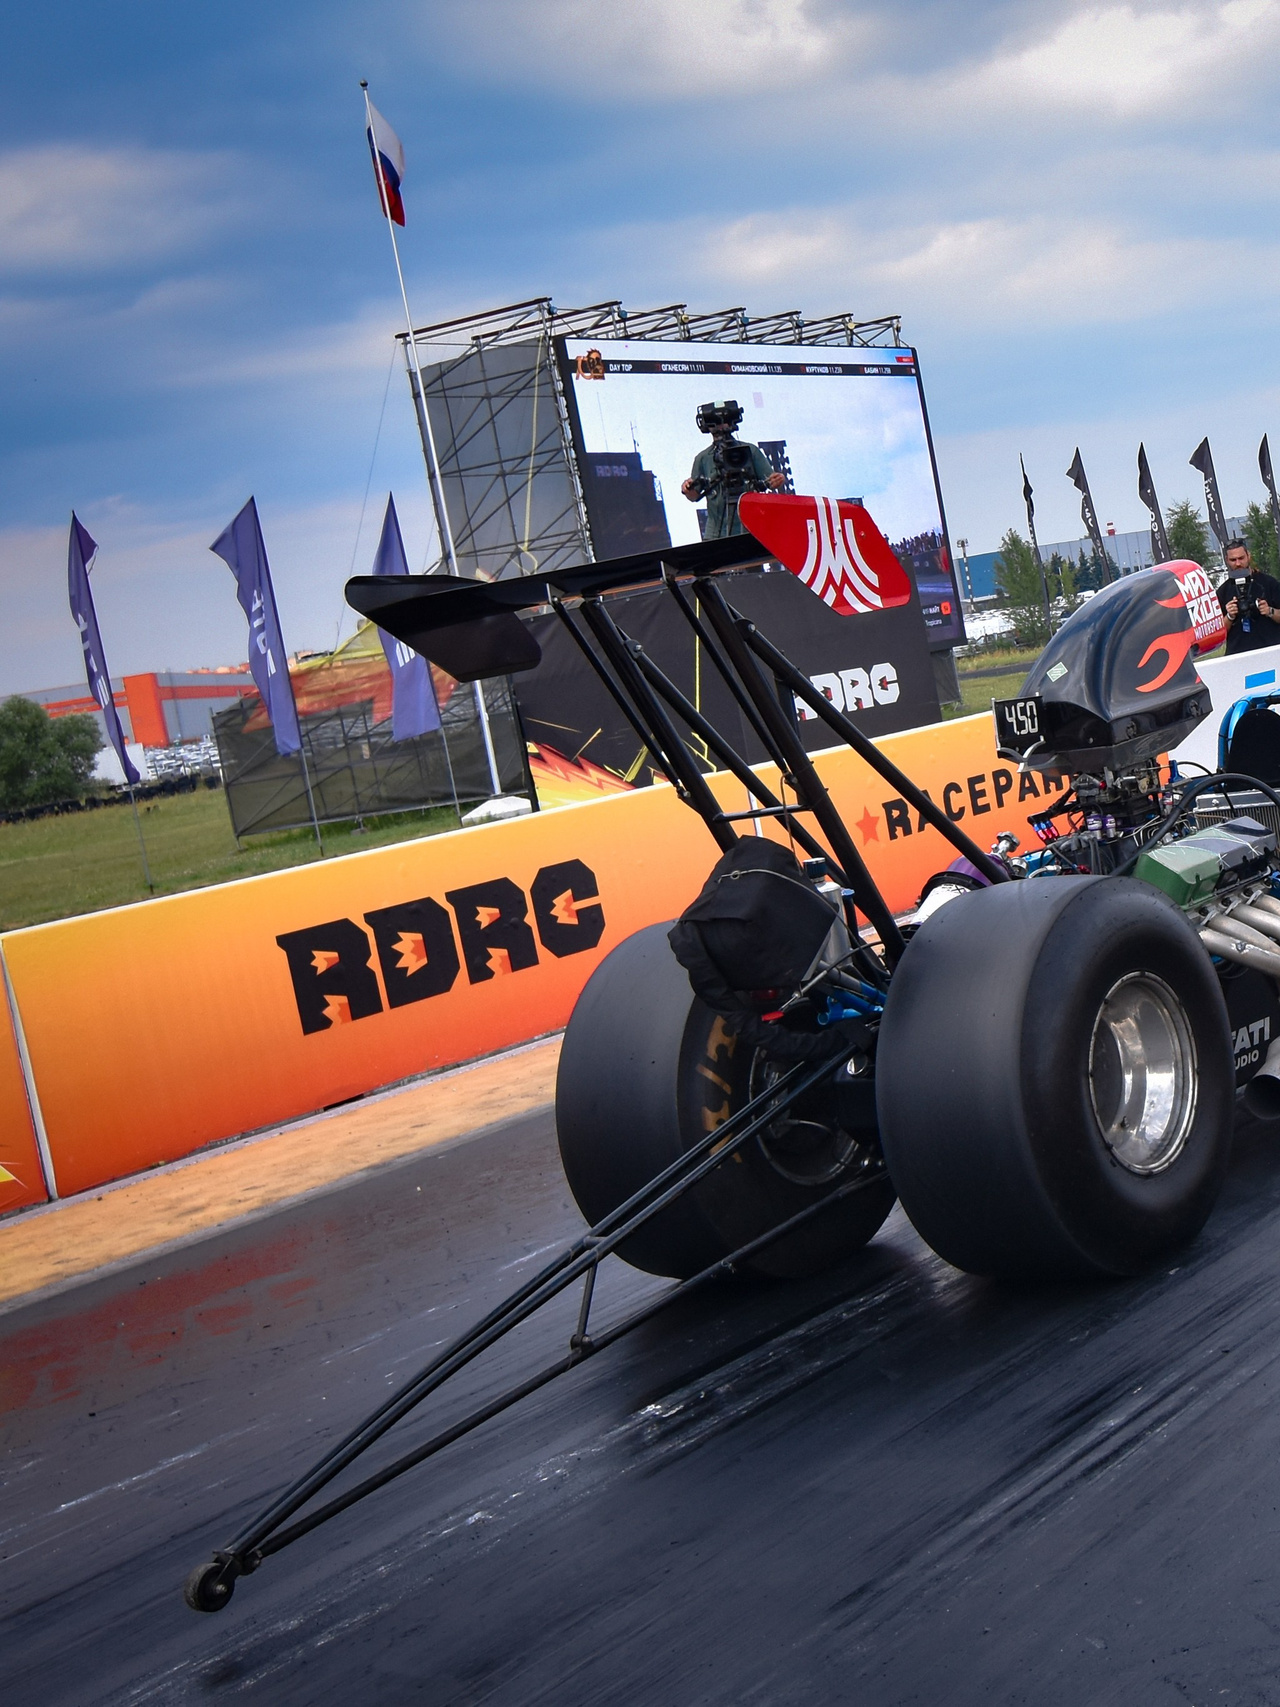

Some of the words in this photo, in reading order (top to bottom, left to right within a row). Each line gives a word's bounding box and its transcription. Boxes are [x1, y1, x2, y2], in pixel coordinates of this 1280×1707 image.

[609, 363, 621, 372] DAY
[621, 363, 633, 372] TOP
[1174, 568, 1214, 604] MAX
[1186, 589, 1223, 627] RIDE
[275, 858, 606, 1036] RDRC
